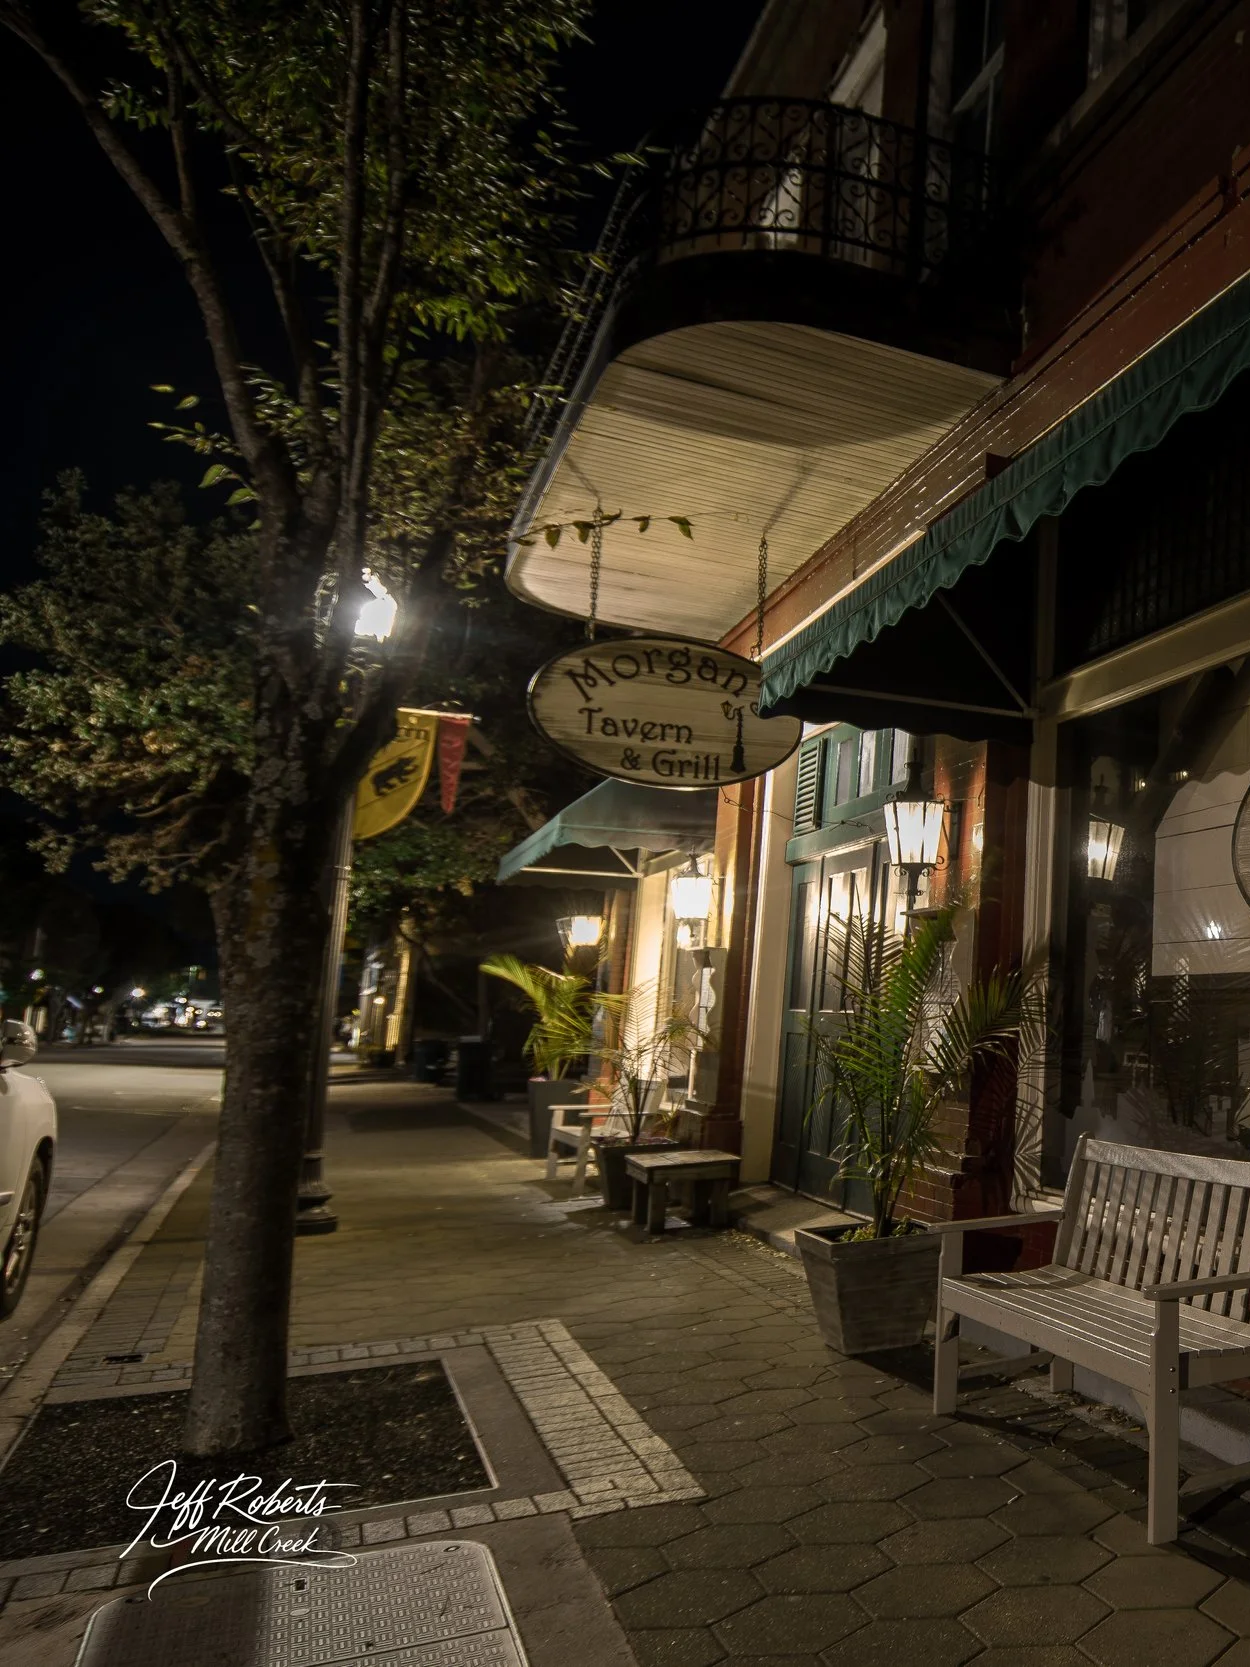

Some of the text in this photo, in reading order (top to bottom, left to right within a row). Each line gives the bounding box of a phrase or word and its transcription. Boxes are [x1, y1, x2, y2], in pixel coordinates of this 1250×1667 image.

[564, 646, 760, 716] Morgan
[578, 706, 693, 745] Tavern
[620, 747, 720, 781] & Grill
